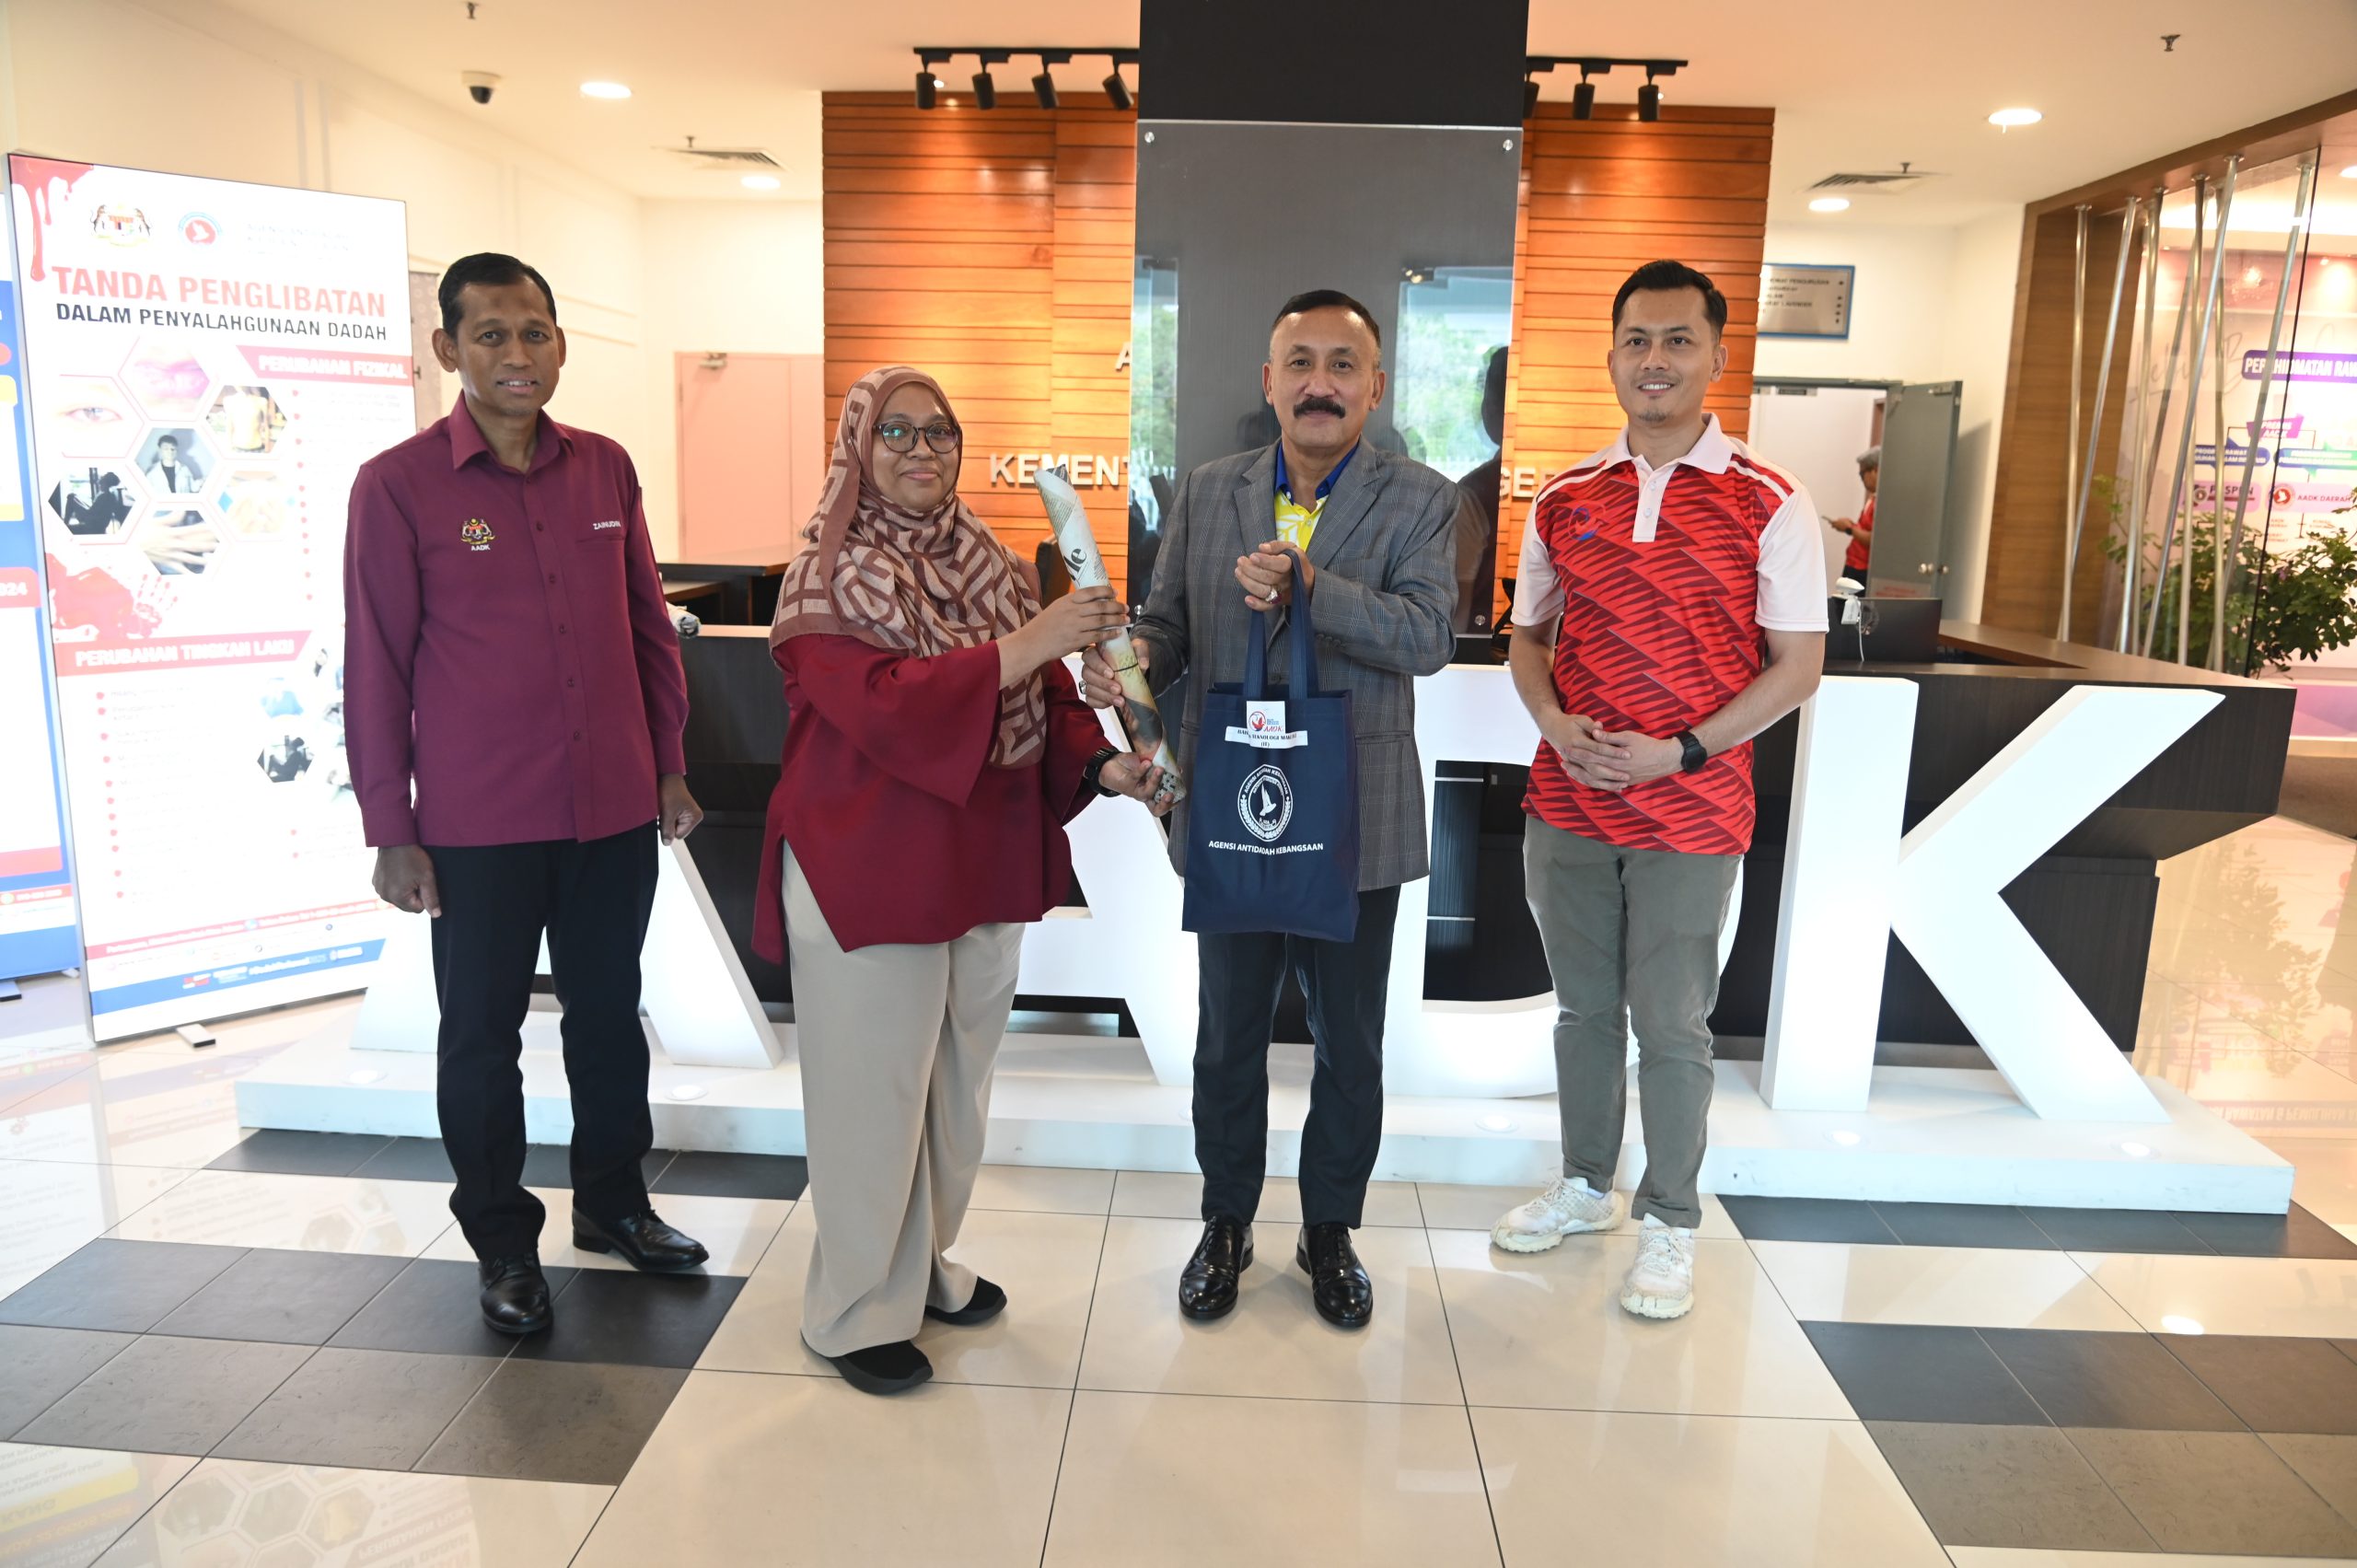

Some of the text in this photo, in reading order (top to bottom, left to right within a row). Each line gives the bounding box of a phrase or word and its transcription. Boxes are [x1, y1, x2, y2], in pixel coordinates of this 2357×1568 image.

[52, 265, 386, 318] TANDA PENGLIBATAN
[56, 303, 387, 341] DALAM PENYALAHGUNAAN DADAH
[989, 452, 1130, 491] KEMEN
[75, 644, 179, 668] PERUBAHAN
[1208, 840, 1324, 855] AGENSI ANTIDADAH KEBANGSAAN
